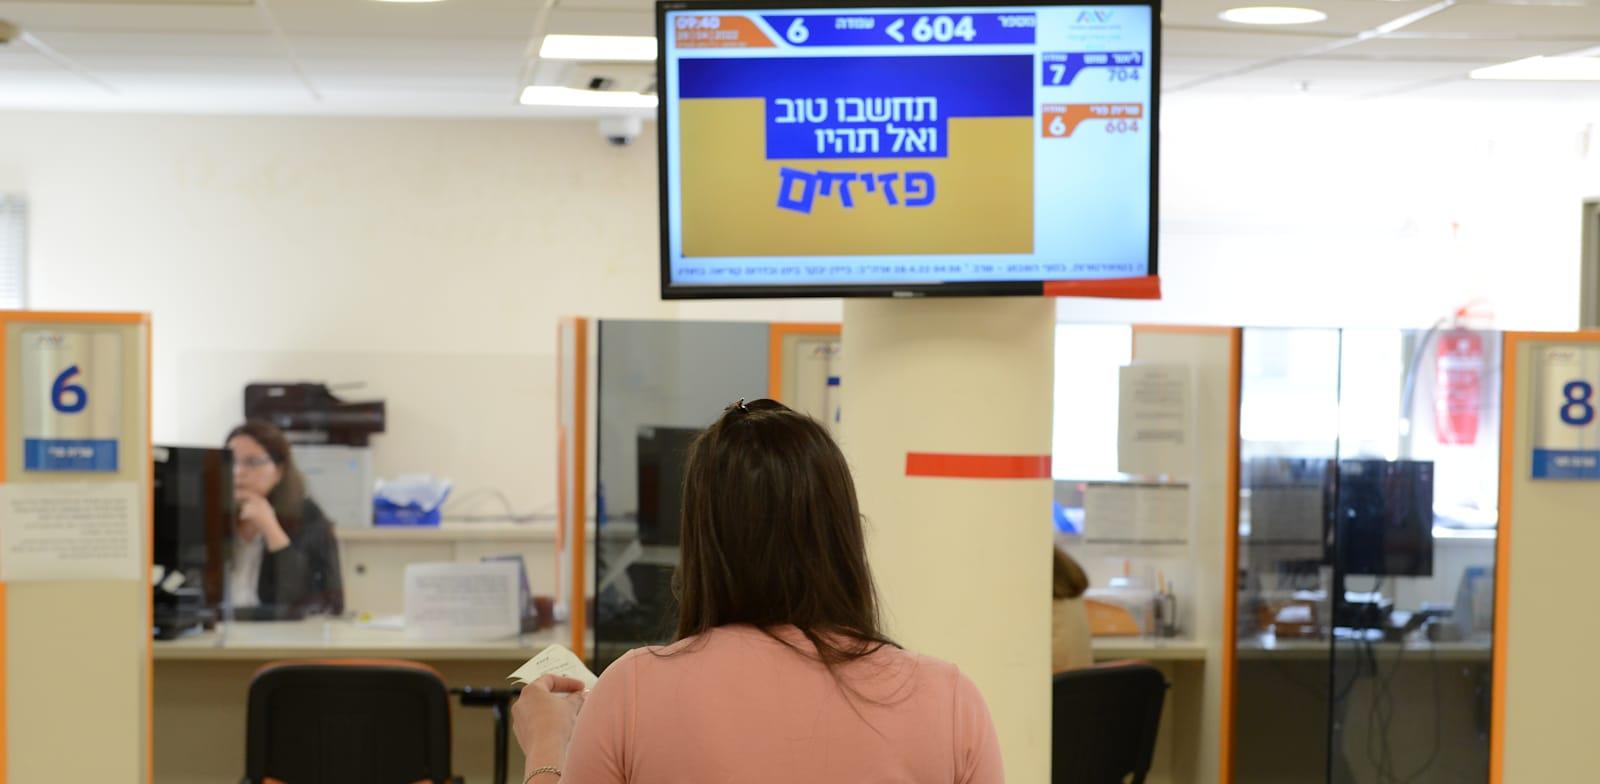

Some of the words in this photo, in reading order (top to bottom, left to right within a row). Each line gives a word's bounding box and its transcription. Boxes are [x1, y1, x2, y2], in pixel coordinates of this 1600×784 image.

[787, 17, 810, 44] 6
[912, 15, 977, 42] 604
[998, 15, 1035, 28] מספר
[1049, 64, 1066, 84] 7
[1108, 69, 1139, 82] 704
[774, 98, 828, 123] טוב
[835, 97, 938, 122] תחשבו
[886, 123, 938, 152] ואל
[1049, 115, 1066, 135] 6
[1105, 120, 1139, 133] 604
[814, 127, 879, 153] תהיו
[777, 167, 935, 215] פזיזים
[51, 365, 88, 414] 6
[1560, 381, 1595, 426] 8
